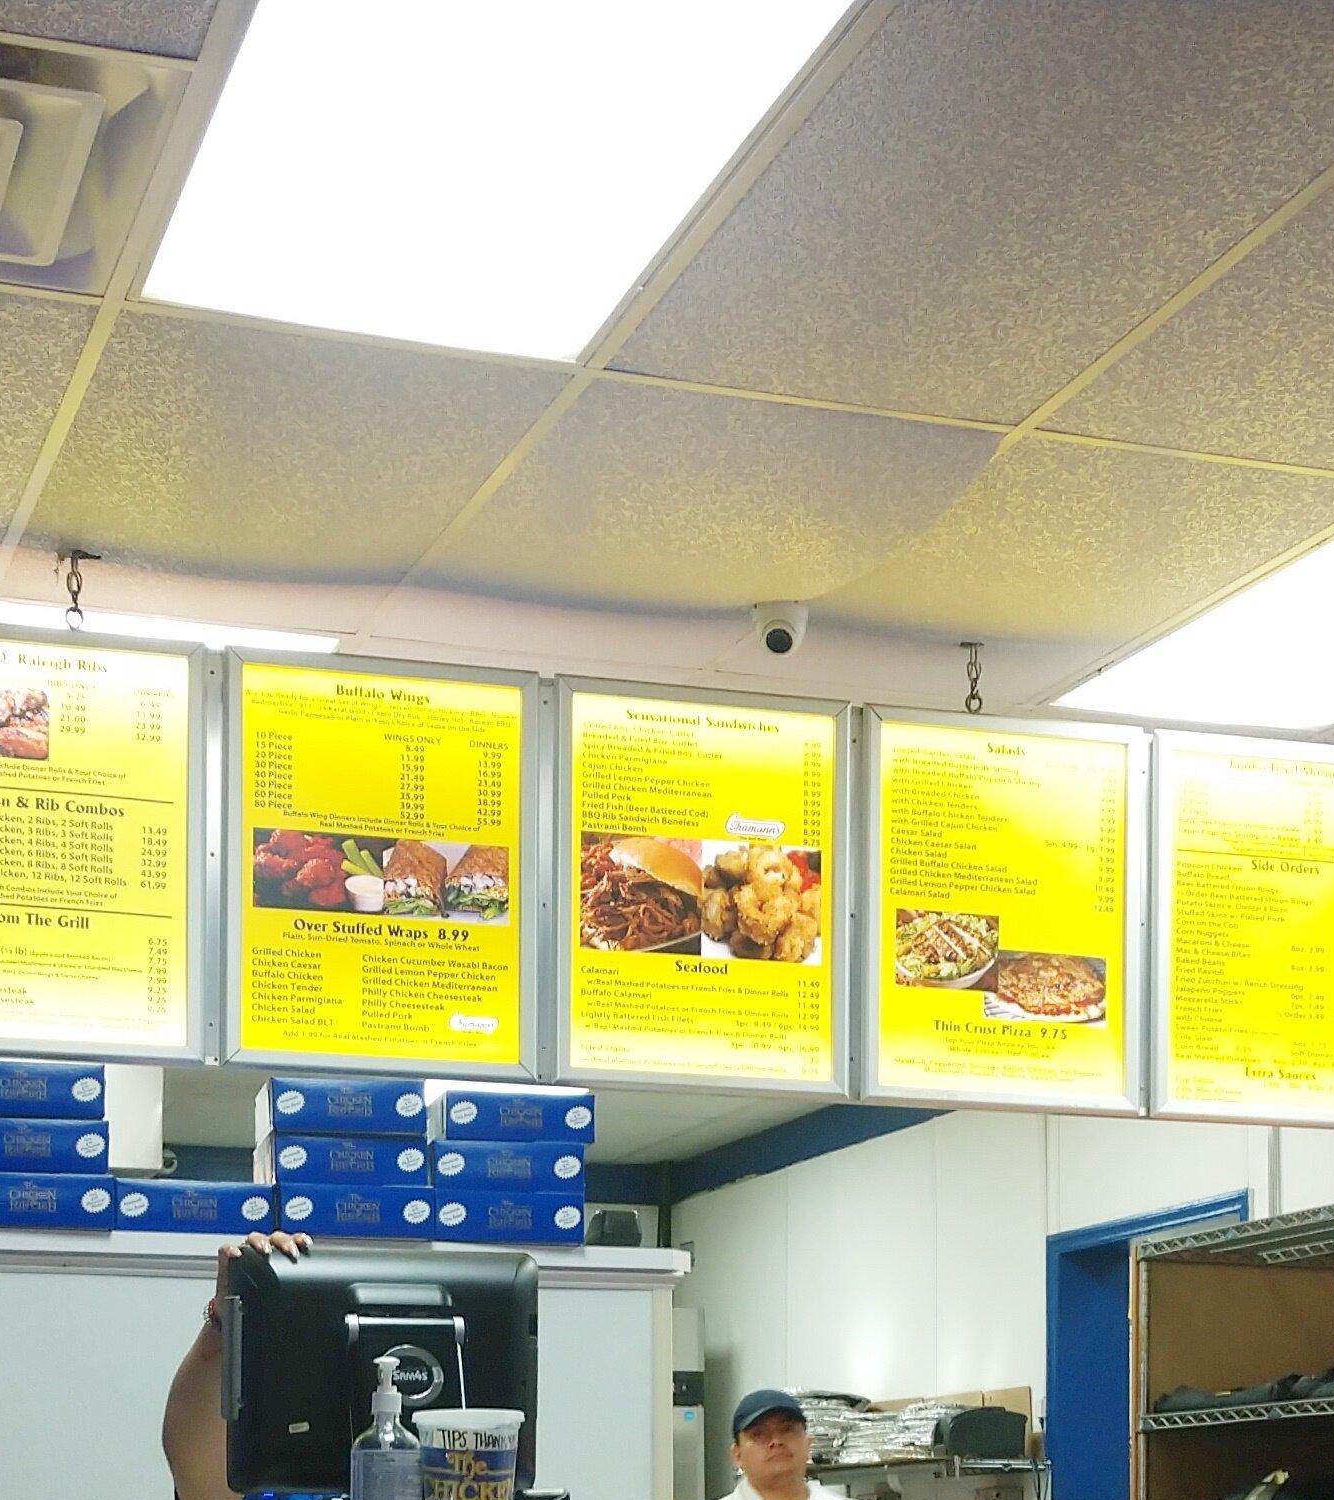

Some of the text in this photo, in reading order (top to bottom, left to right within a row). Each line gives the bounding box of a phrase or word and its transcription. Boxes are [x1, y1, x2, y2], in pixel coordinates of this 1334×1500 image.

[78, 658, 108, 673] Ribs
[335, 683, 431, 706] Buffalo Wings
[16, 795, 30, 809] &
[35, 797, 60, 812] Rib
[65, 800, 125, 818] Combos
[1251, 859, 1319, 875] Side Orders
[25, 912, 53, 928] The
[58, 913, 90, 929] Grill
[293, 918, 469, 942] Over Stuffed Wraps 8.99
[251, 947, 322, 959] Grilled Chicken
[251, 958, 321, 970] Chicken Caesar
[361, 953, 397, 965] Chicken
[400, 956, 445, 967] Cucumber
[482, 961, 508, 972] Bacon
[675, 960, 728, 976] Seafood
[251, 969, 323, 981] Buffalo Chicken
[361, 964, 496, 981] Grilled Lemon Pepper Chicken
[251, 980, 323, 993] Chicken Tender
[933, 1020, 1067, 1041] Thin Crust Pizza 9.75
[1275, 1069, 1317, 1082] Sauces
[437, 1429, 468, 1448] TIPS
